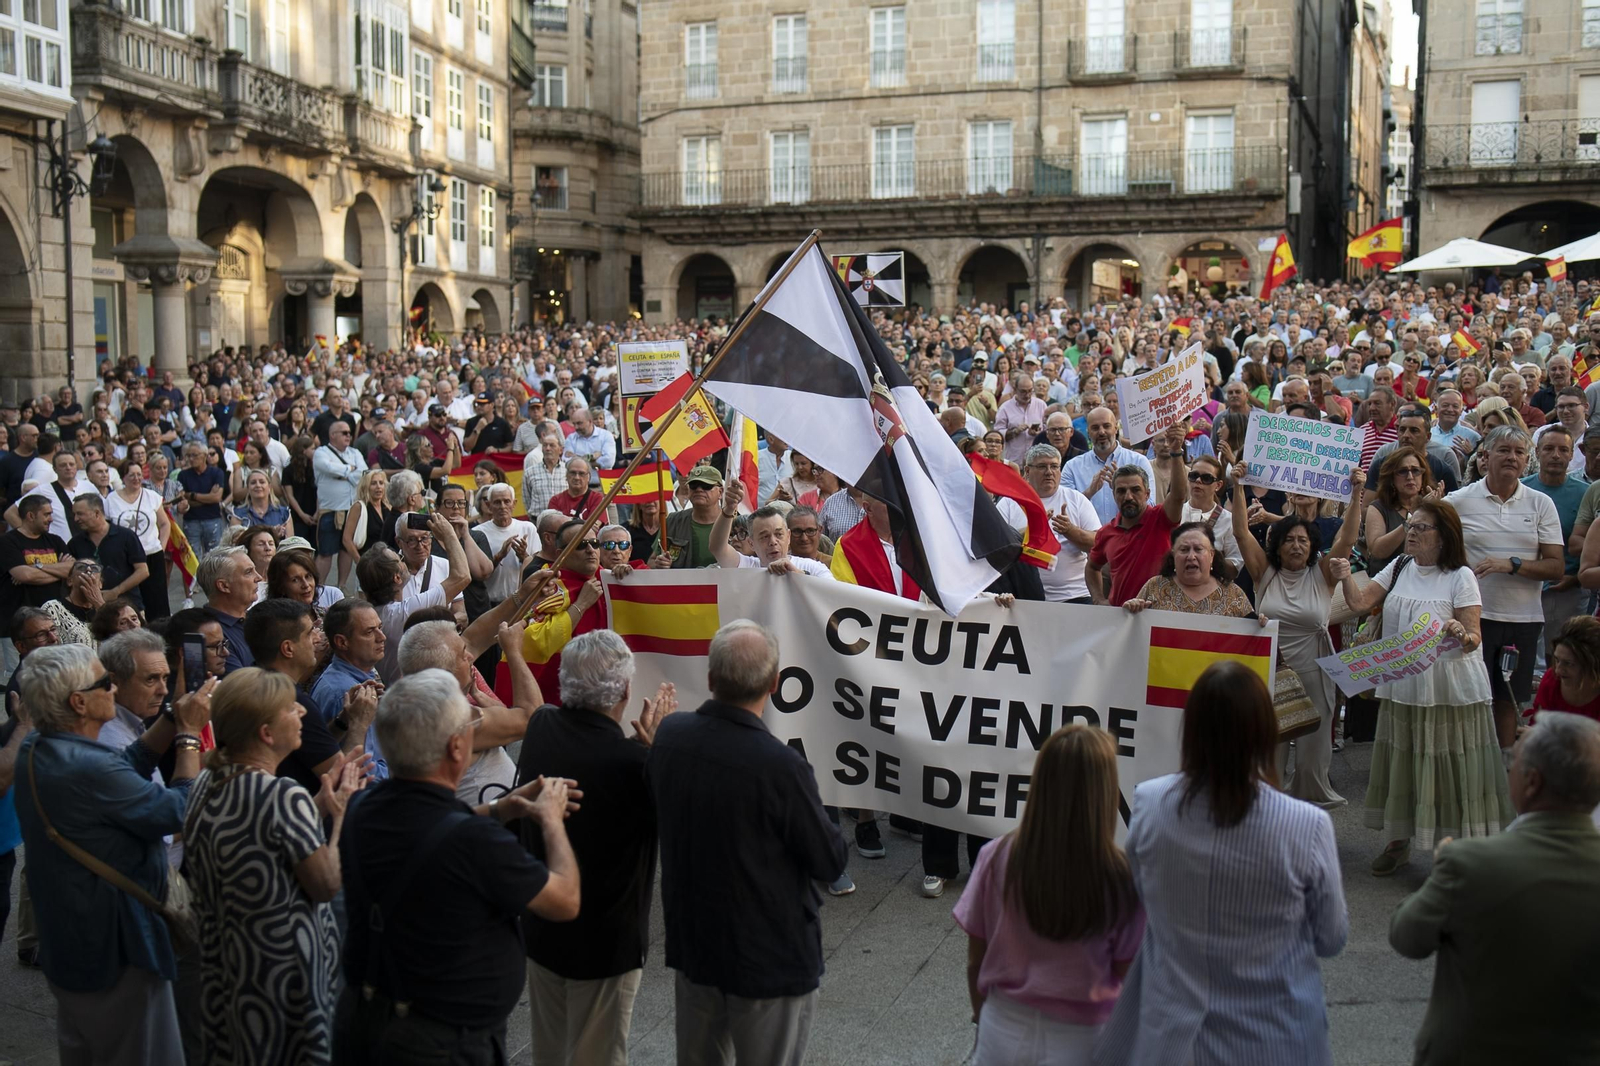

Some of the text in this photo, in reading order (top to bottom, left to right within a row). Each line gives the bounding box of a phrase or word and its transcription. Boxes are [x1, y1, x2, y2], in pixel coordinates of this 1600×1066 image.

[660, 352, 680, 360] ESPAÑA
[1178, 360, 1185, 375] A
[1185, 351, 1198, 371] LAS
[1156, 404, 1178, 418] PARA
[1180, 393, 1190, 407] LOS
[1253, 444, 1350, 476] Y RESPETO A LA
[1257, 430, 1362, 463] PERO CON DEBERES
[1247, 461, 1266, 477] LEY
[1269, 464, 1280, 482] Y
[1280, 466, 1299, 485] AL
[1302, 469, 1352, 496] PUEBLO
[825, 607, 1031, 675] CEUTA
[1347, 659, 1371, 673] EN
[1372, 648, 1404, 664] LAS
[1403, 620, 1440, 653] CALLES
[1349, 666, 1386, 681] PARA
[771, 666, 814, 713] O
[832, 677, 900, 735] SE
[832, 741, 900, 795] SE
